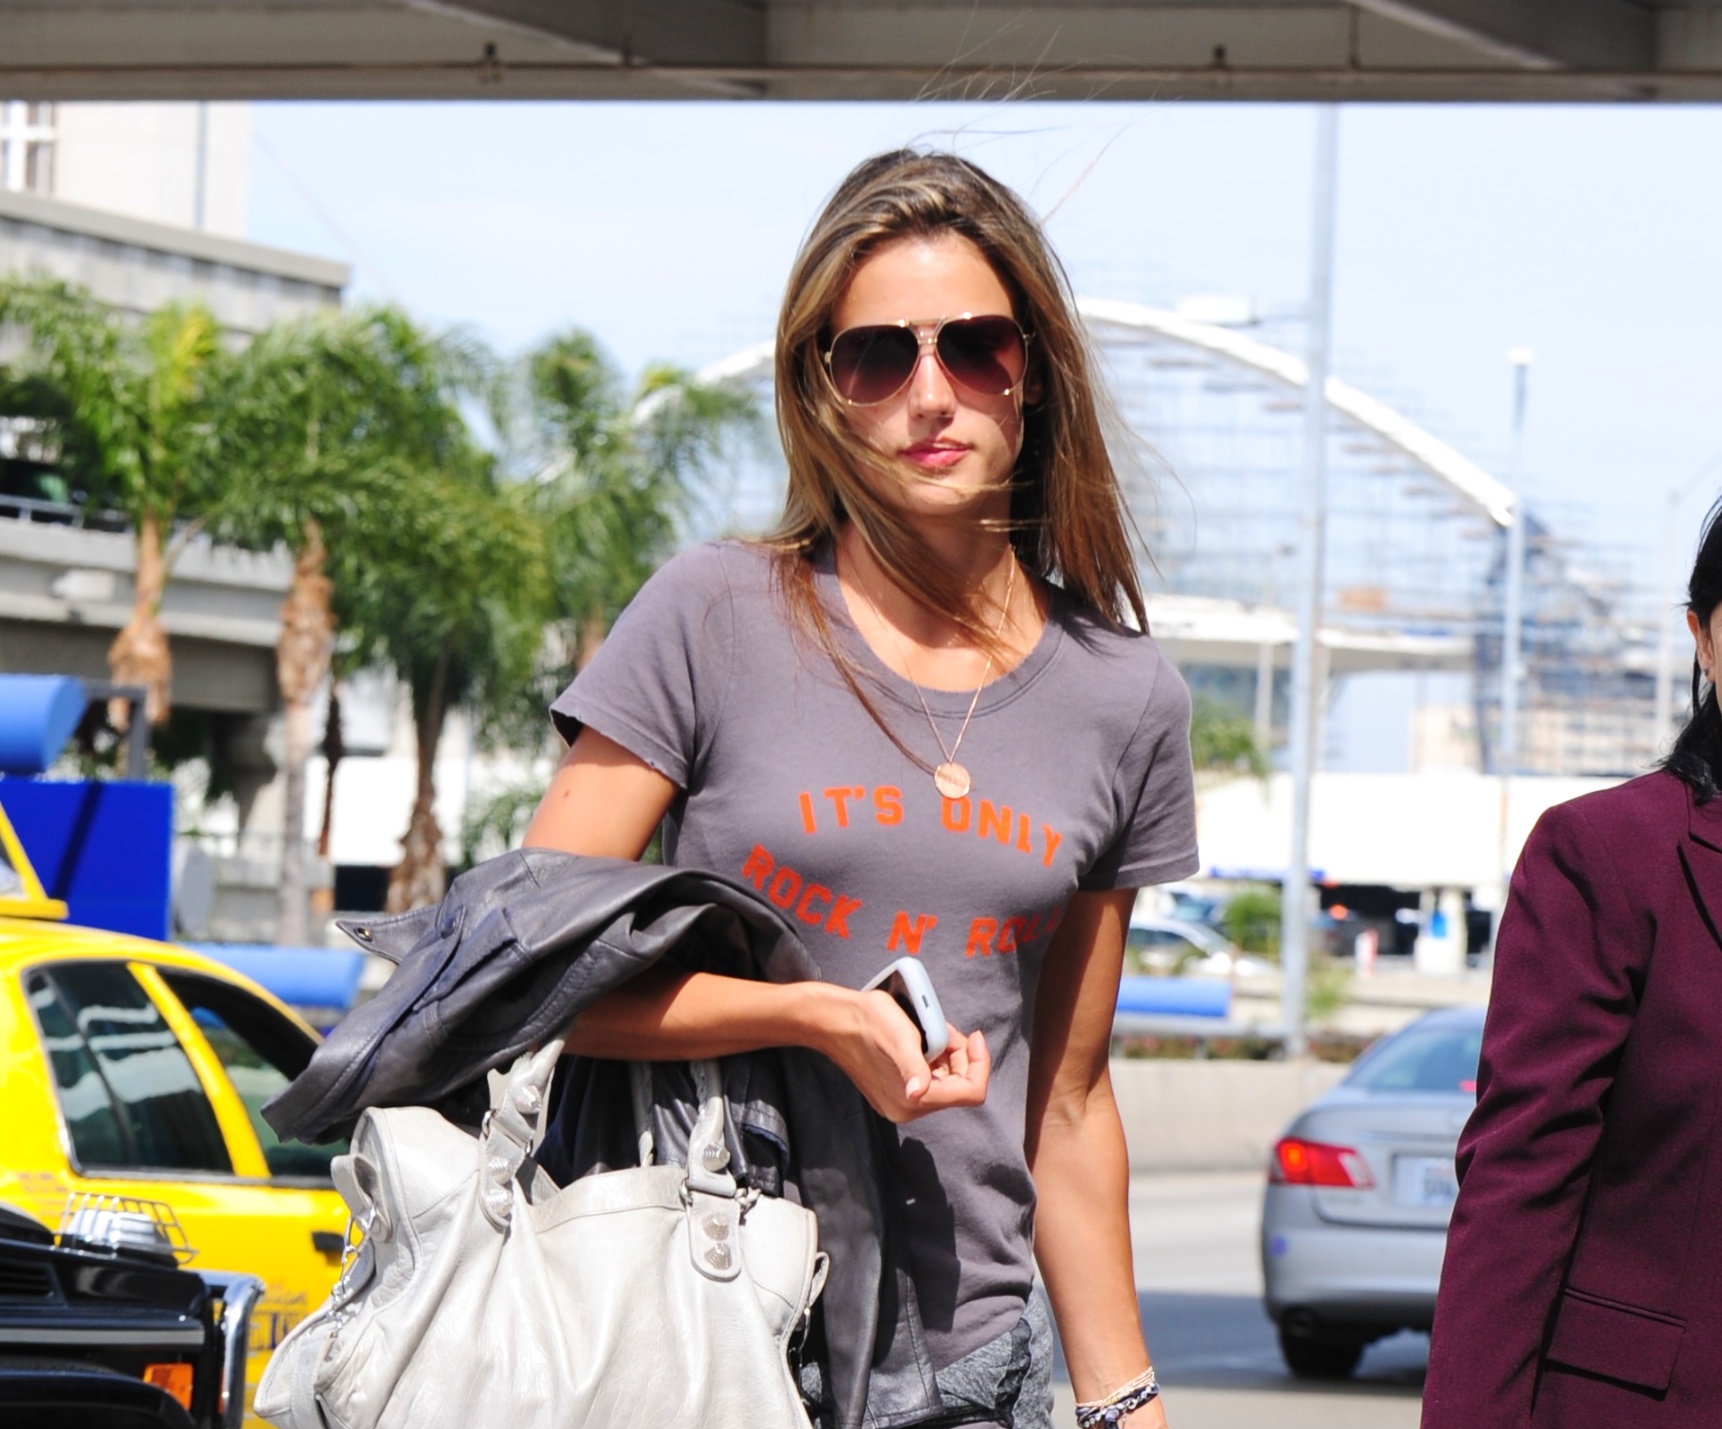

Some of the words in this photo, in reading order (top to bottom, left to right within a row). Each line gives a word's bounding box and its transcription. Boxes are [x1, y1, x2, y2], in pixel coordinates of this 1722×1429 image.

[799, 785, 903, 835] IT'S
[941, 796, 1063, 868] ONLY
[742, 842, 863, 940] ROCK
[886, 911, 938, 956] N'
